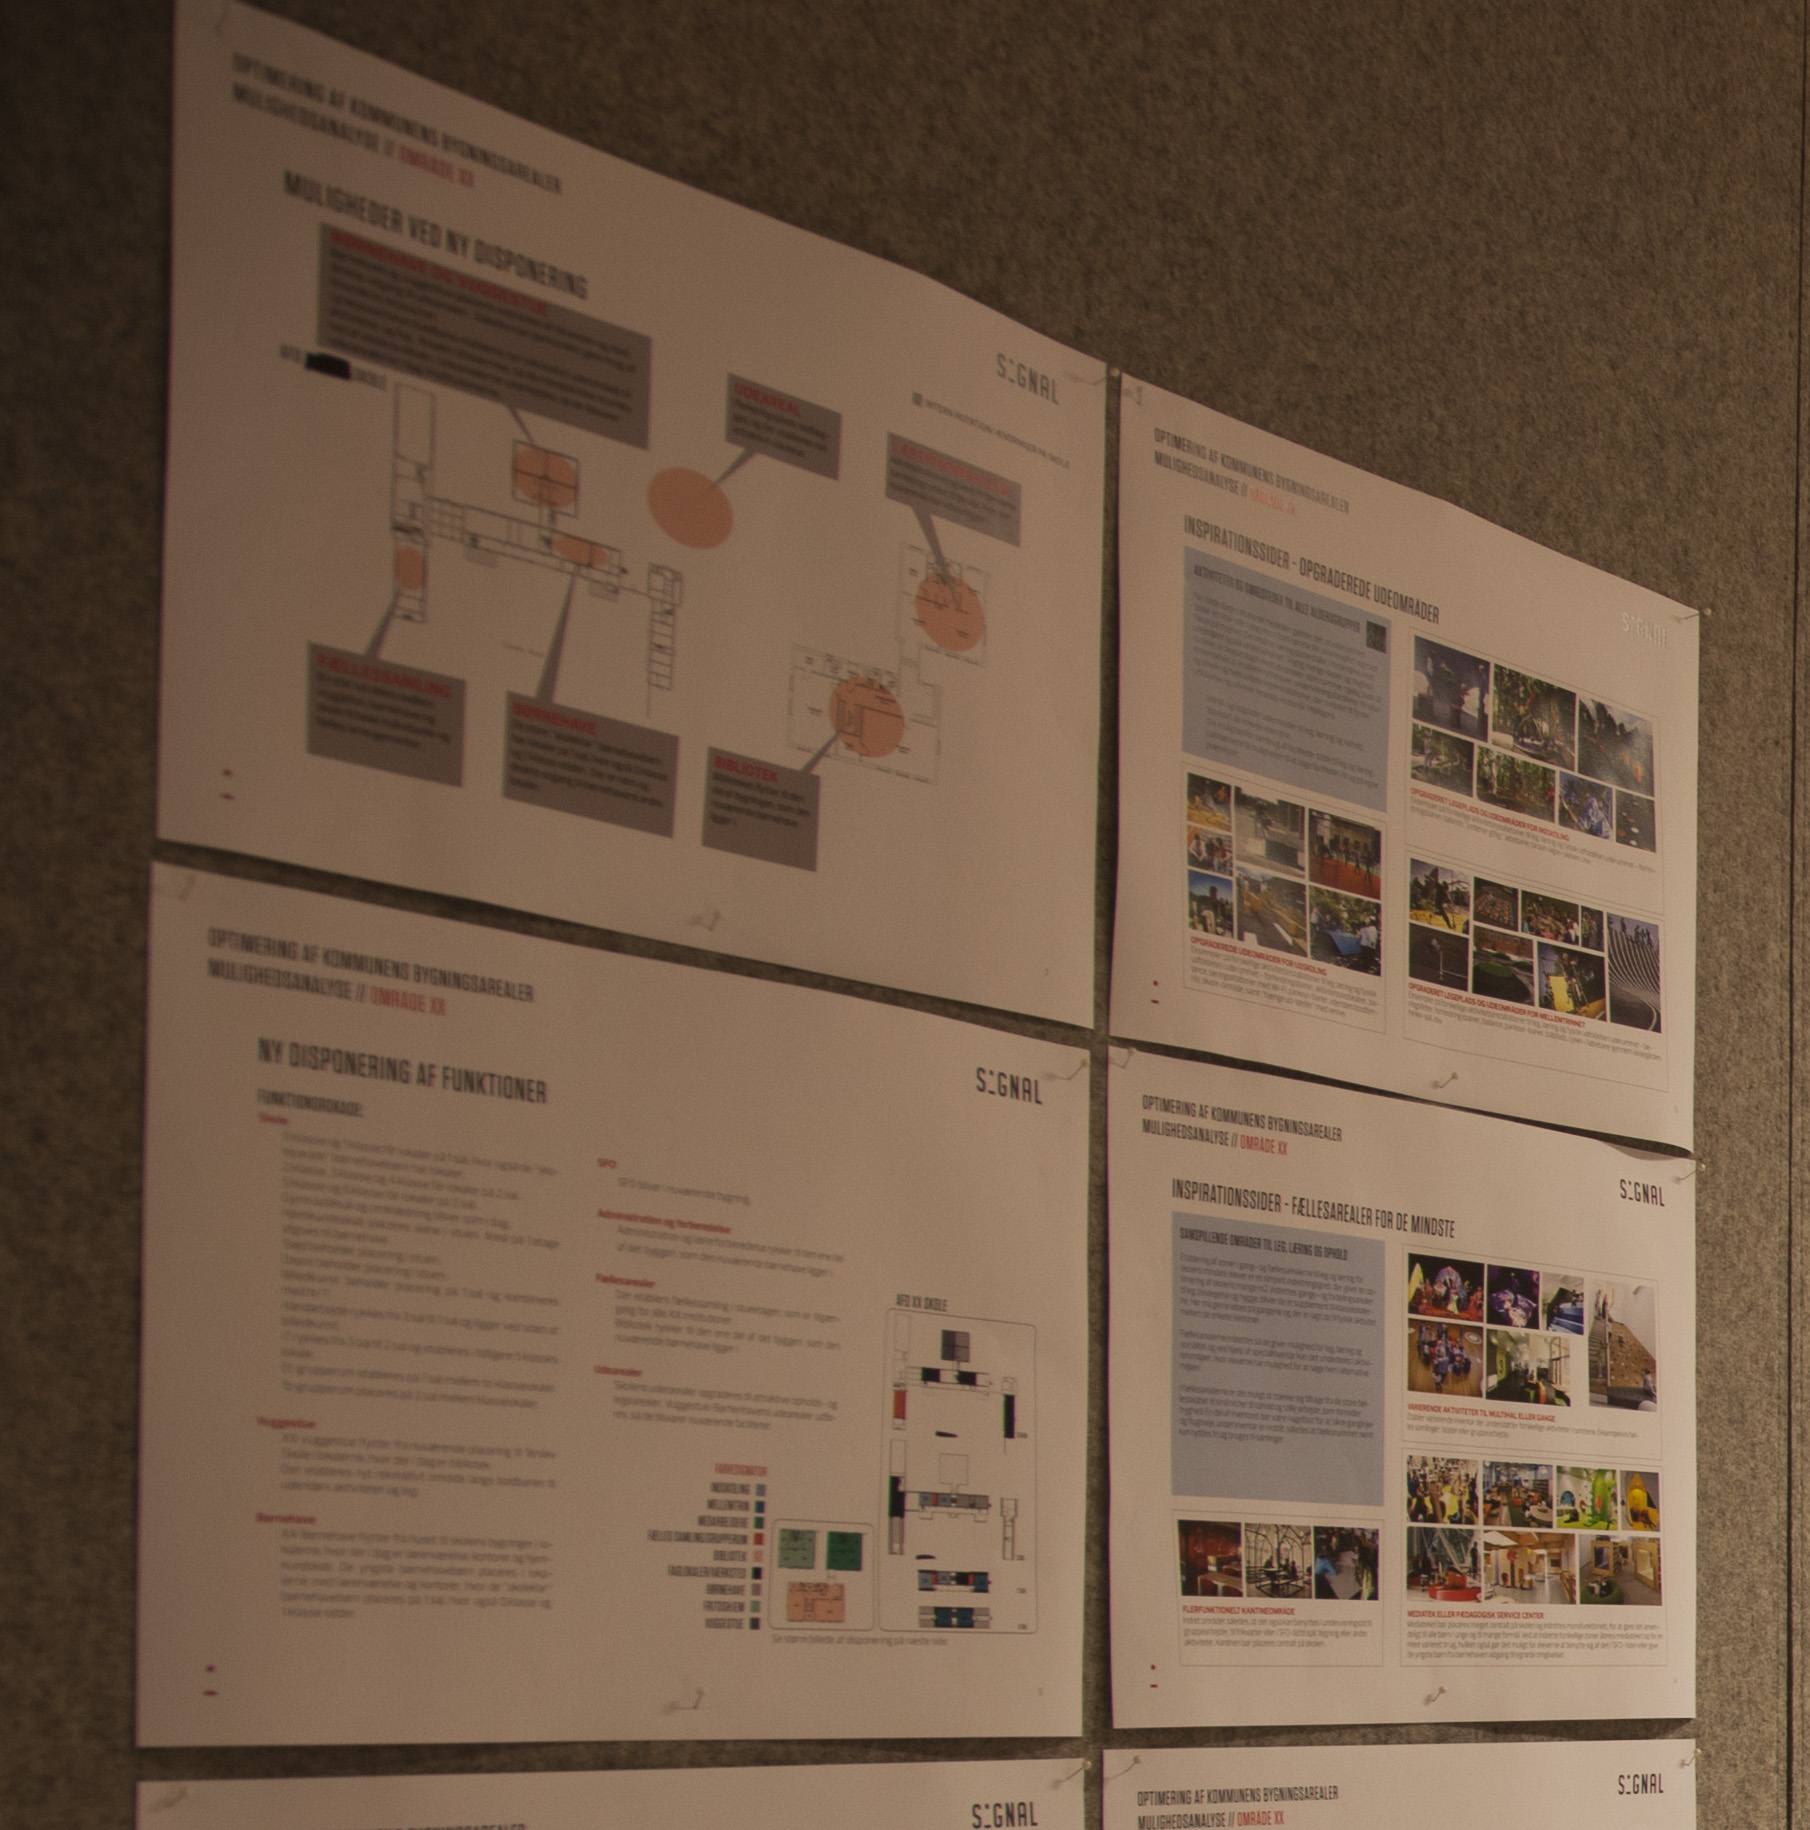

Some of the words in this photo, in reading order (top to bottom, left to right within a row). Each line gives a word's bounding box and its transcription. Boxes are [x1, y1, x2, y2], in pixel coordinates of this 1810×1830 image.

[1184, 514, 1289, 570] INSPIRATIONSSIDER
[1300, 556, 1371, 599] OPGRADEREDE
[258, 1037, 283, 1067] NY
[287, 1041, 411, 1085] DISPONERING
[415, 1060, 436, 1089] AF
[440, 1064, 548, 1105] FUNKTIONER
[1142, 1095, 1196, 1119] OPTIMERING
[1198, 1104, 1208, 1121] AF
[1210, 1106, 1265, 1130] KOMMUNENS
[1267, 1114, 1342, 1142] BYGNINGSAREALER
[1172, 1178, 1281, 1213] INSPIRATIONSSIDER
[1374, 1207, 1393, 1229] FOR
[1396, 1210, 1408, 1232] DE
[1410, 1212, 1455, 1238] MINDSTE
[1137, 1790, 1191, 1806] OPTIMERING
[1194, 1789, 1204, 1804] AF
[1206, 1788, 1260, 1804] KOMMUNENS
[1262, 1786, 1338, 1802] BYGNINGSAREALER
